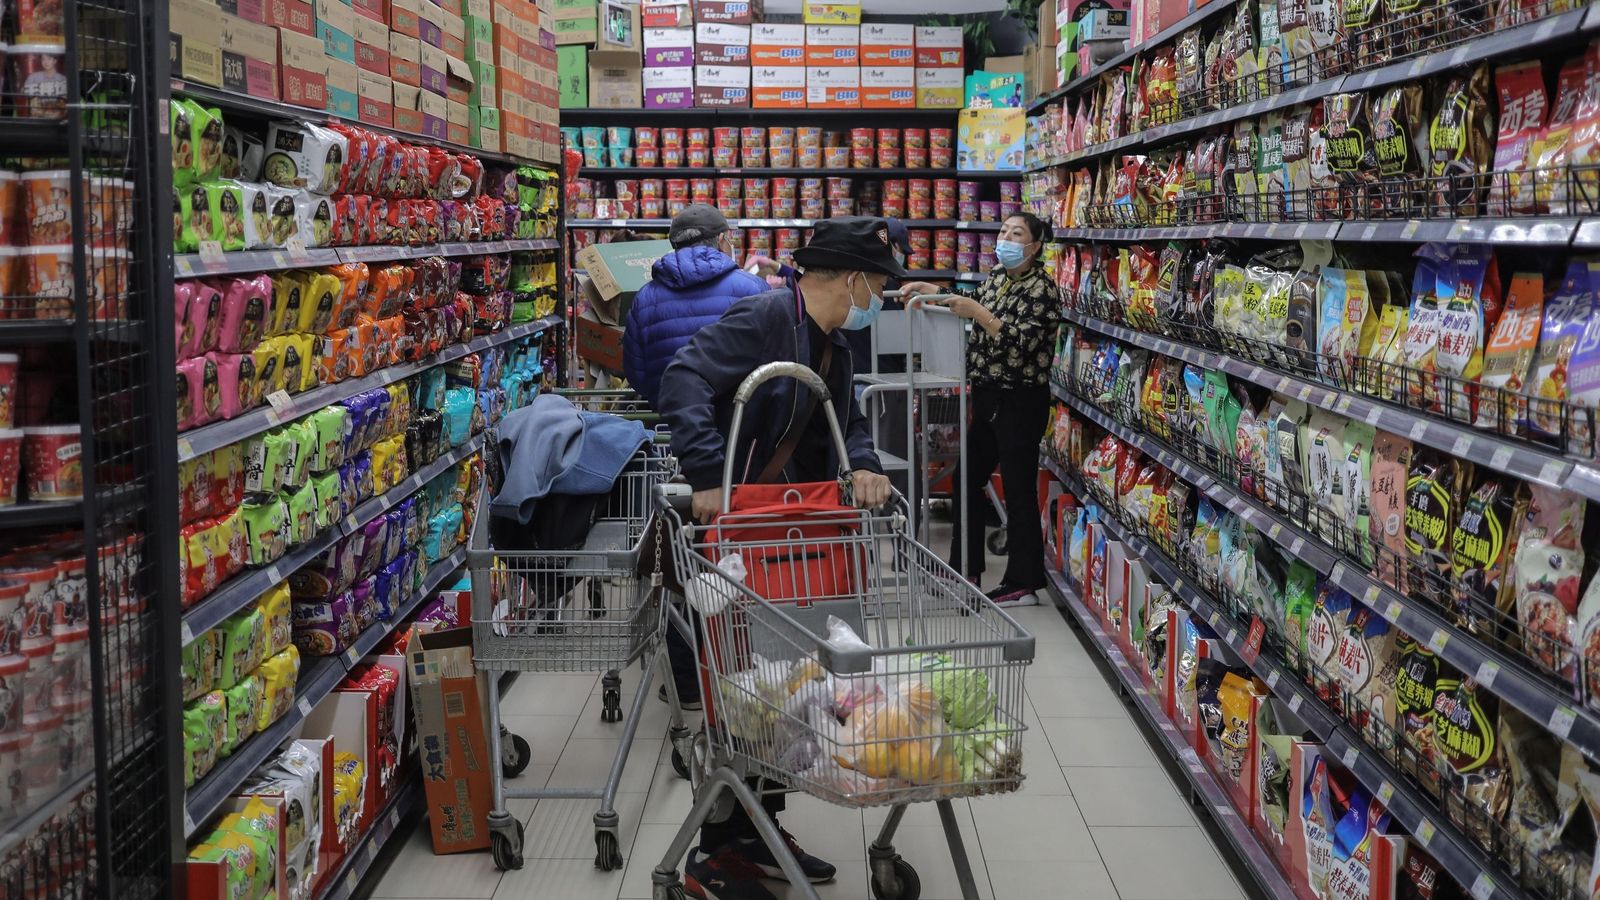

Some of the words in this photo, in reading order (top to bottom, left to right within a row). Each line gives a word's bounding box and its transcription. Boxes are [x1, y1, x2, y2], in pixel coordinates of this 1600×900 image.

[726, 3, 747, 12] BIG
[725, 46, 746, 56] BIG
[781, 48, 803, 58] BIG
[835, 48, 856, 58] BIG
[890, 49, 912, 58] BIG
[724, 89, 746, 98] BIG
[781, 91, 803, 100] BIG
[836, 91, 858, 100] BIG
[891, 90, 912, 99] BIG
[1499, 88, 1545, 140] 西麦
